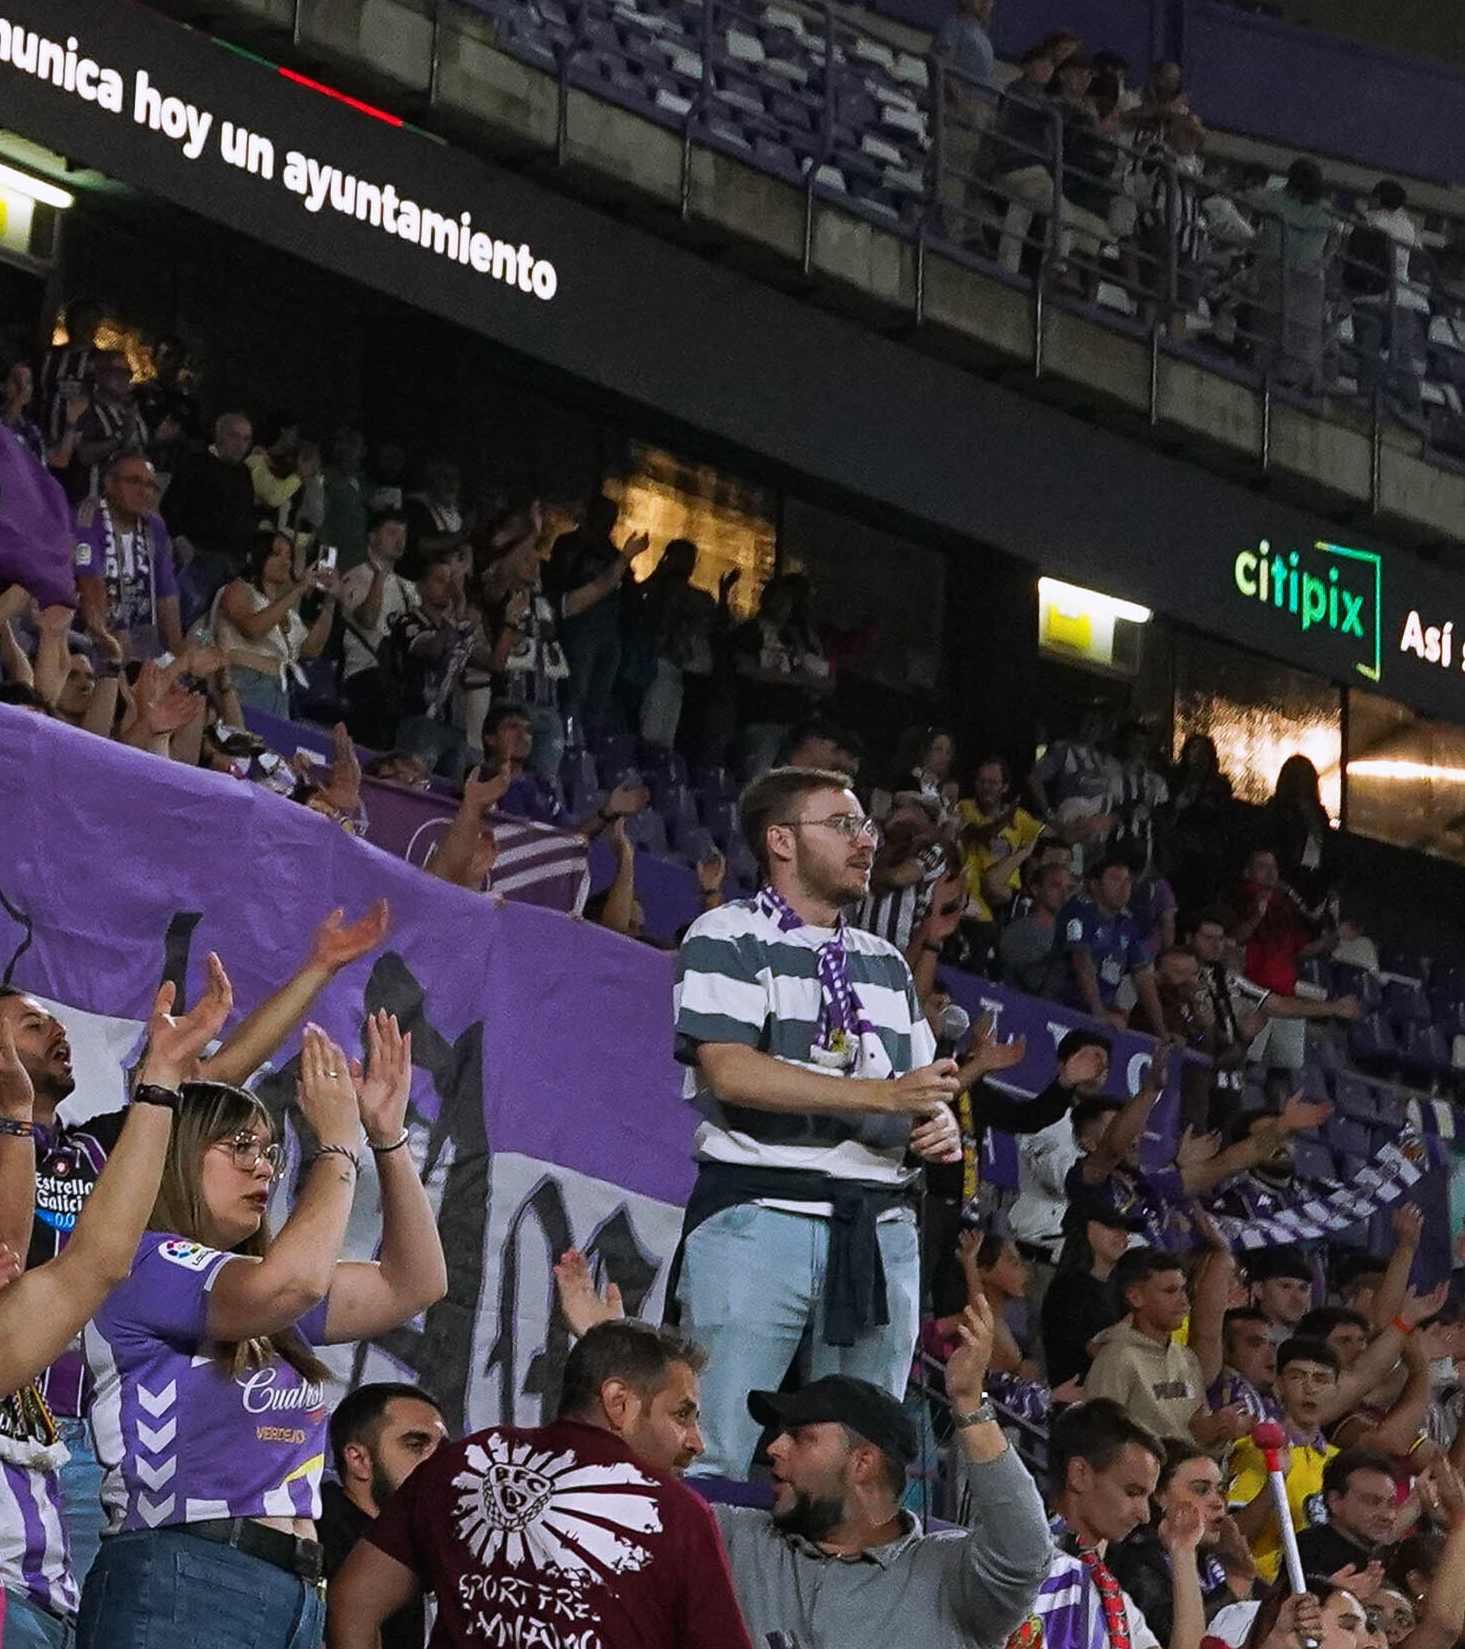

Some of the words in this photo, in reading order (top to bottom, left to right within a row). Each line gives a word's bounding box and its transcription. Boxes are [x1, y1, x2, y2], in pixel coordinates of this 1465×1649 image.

[134, 69, 213, 159] hoy
[220, 120, 275, 180] un
[282, 146, 558, 302] ayuntamiento
[1234, 538, 1365, 639] citipix
[1400, 610, 1454, 668] Así
[35, 1170, 94, 1195] Estrella
[36, 1188, 83, 1212] Galici
[459, 1574, 534, 1609] SPORT
